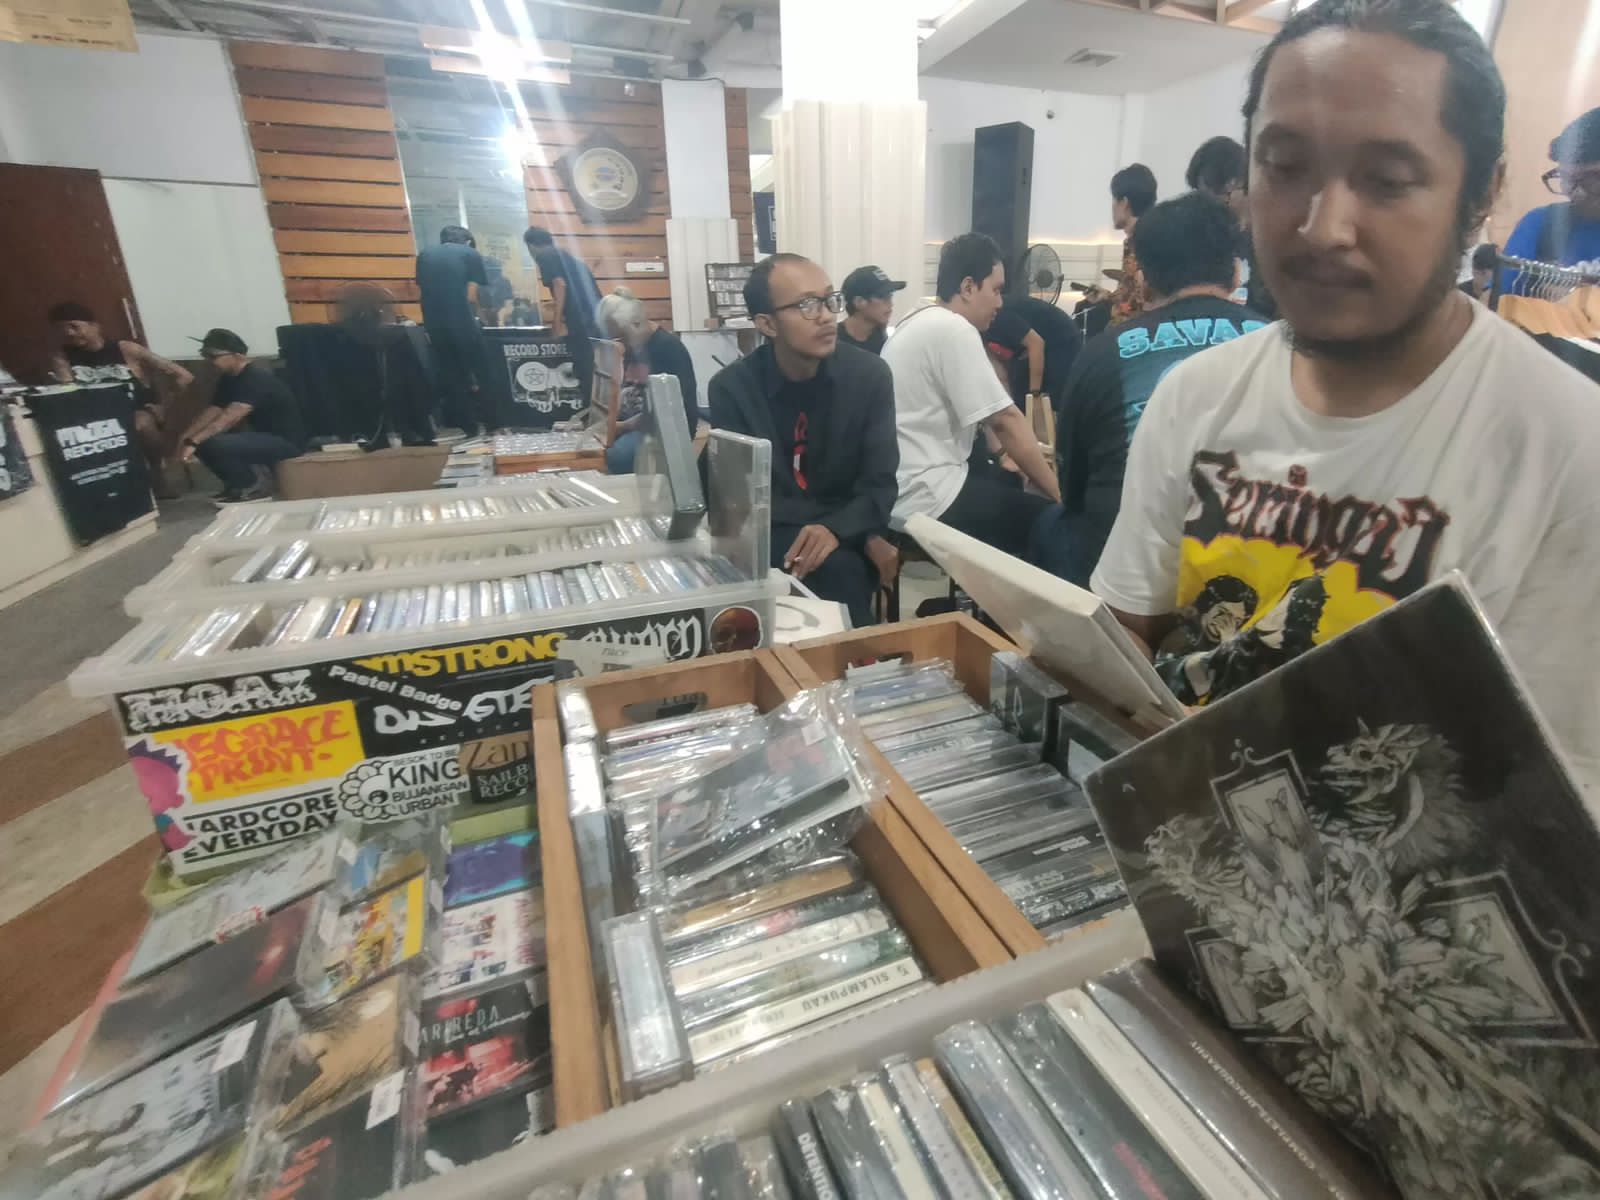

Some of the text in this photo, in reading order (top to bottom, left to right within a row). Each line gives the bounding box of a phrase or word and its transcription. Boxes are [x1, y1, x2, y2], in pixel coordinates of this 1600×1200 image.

[503, 343, 538, 356] RECORD
[62, 434, 129, 461] RECORDS
[328, 664, 462, 711] Pastel Badge
[430, 752, 442, 761] TO
[388, 758, 460, 789] KING
[391, 780, 468, 802] BUJANGAN
[186, 793, 338, 832] ARDCORE
[400, 796, 457, 815] URBAN
